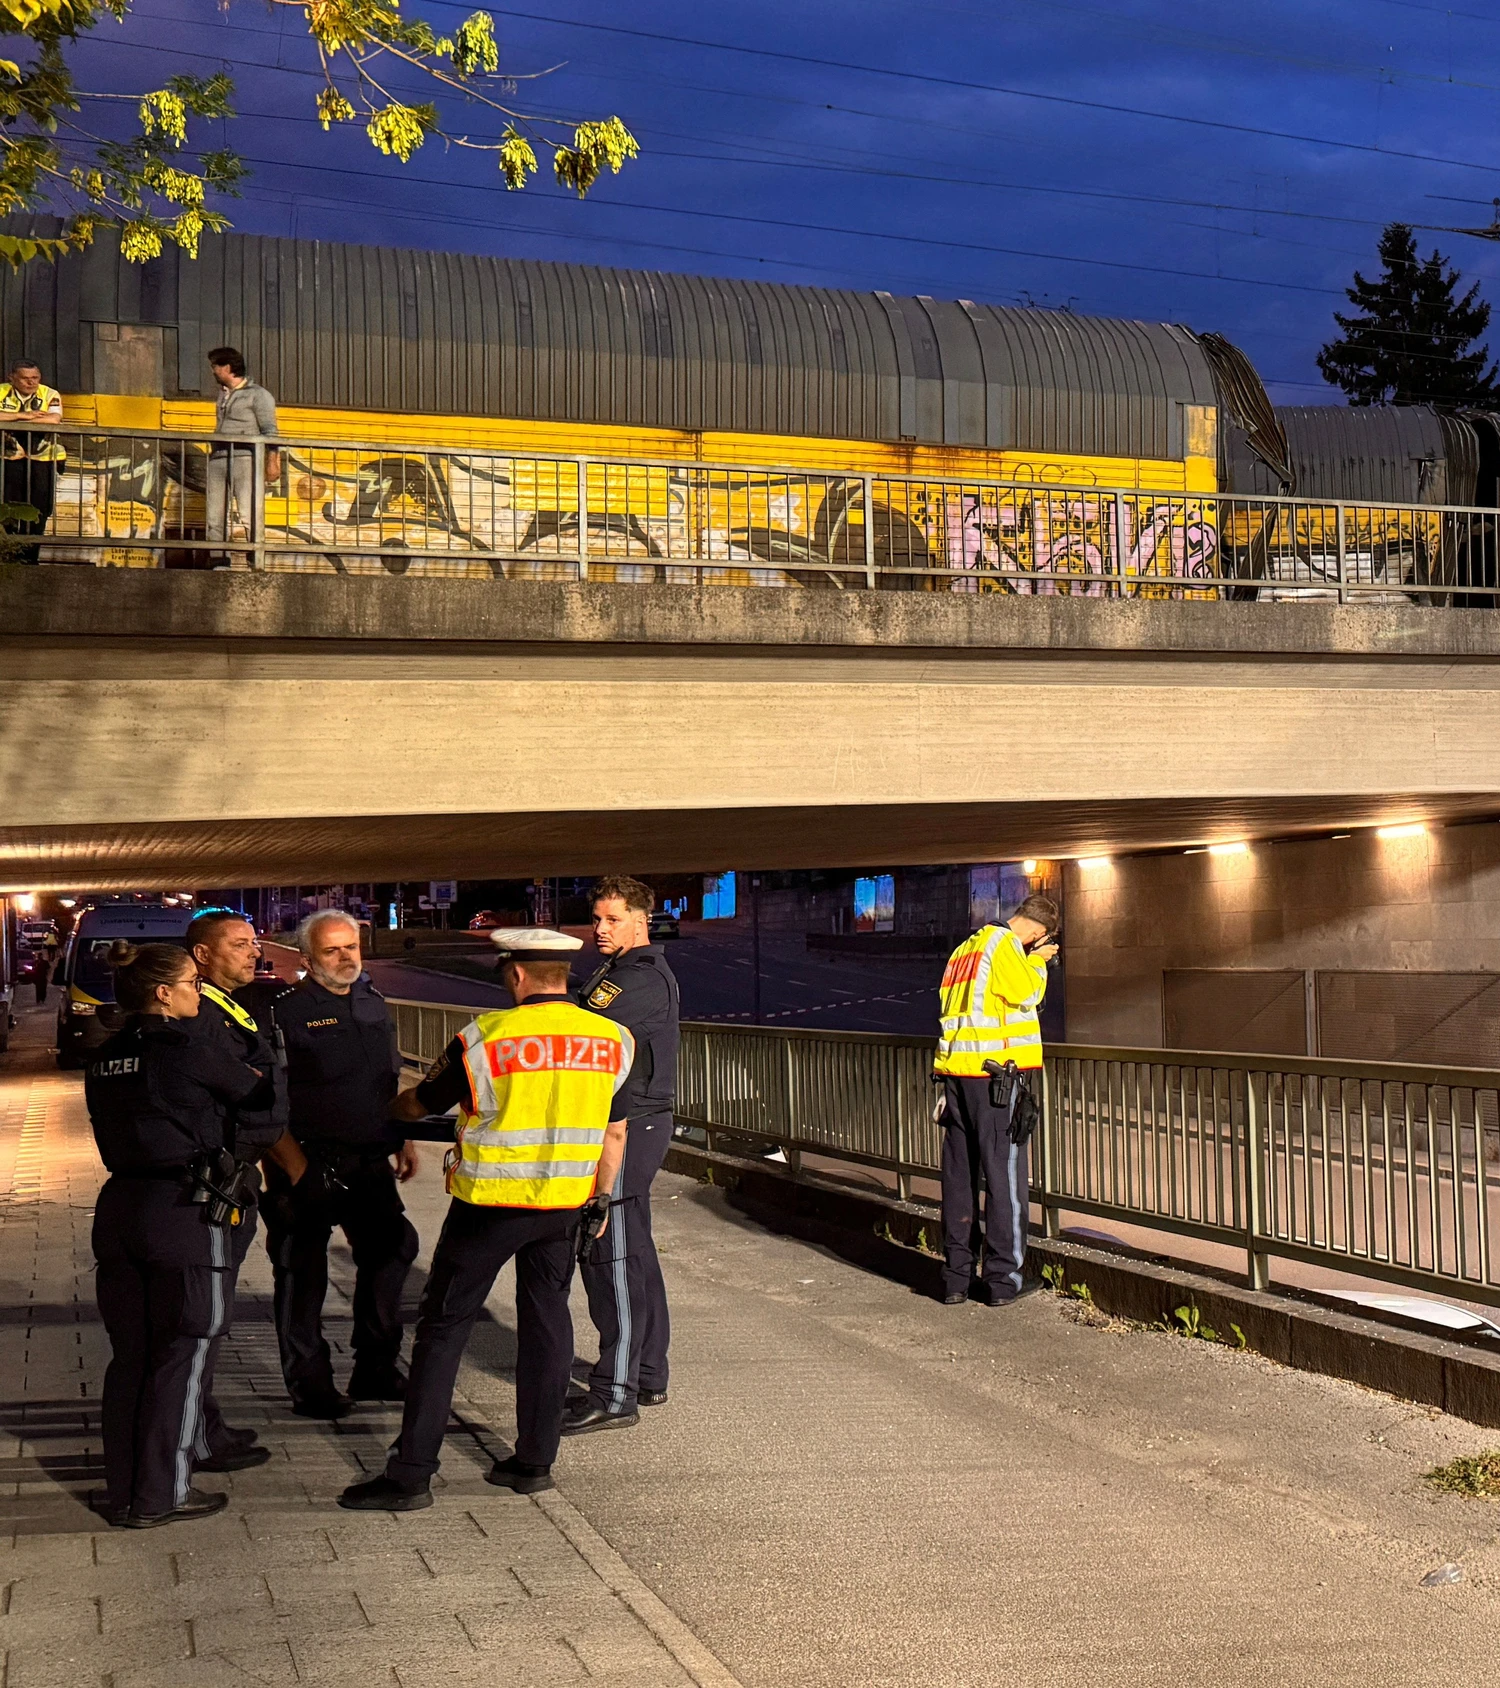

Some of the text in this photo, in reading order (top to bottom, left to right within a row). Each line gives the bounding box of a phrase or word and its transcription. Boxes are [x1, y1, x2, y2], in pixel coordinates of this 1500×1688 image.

[306, 1017, 339, 1029] POLIZEI
[496, 1035, 615, 1073] POLIZEI
[91, 1057, 140, 1077] OLIZEI
